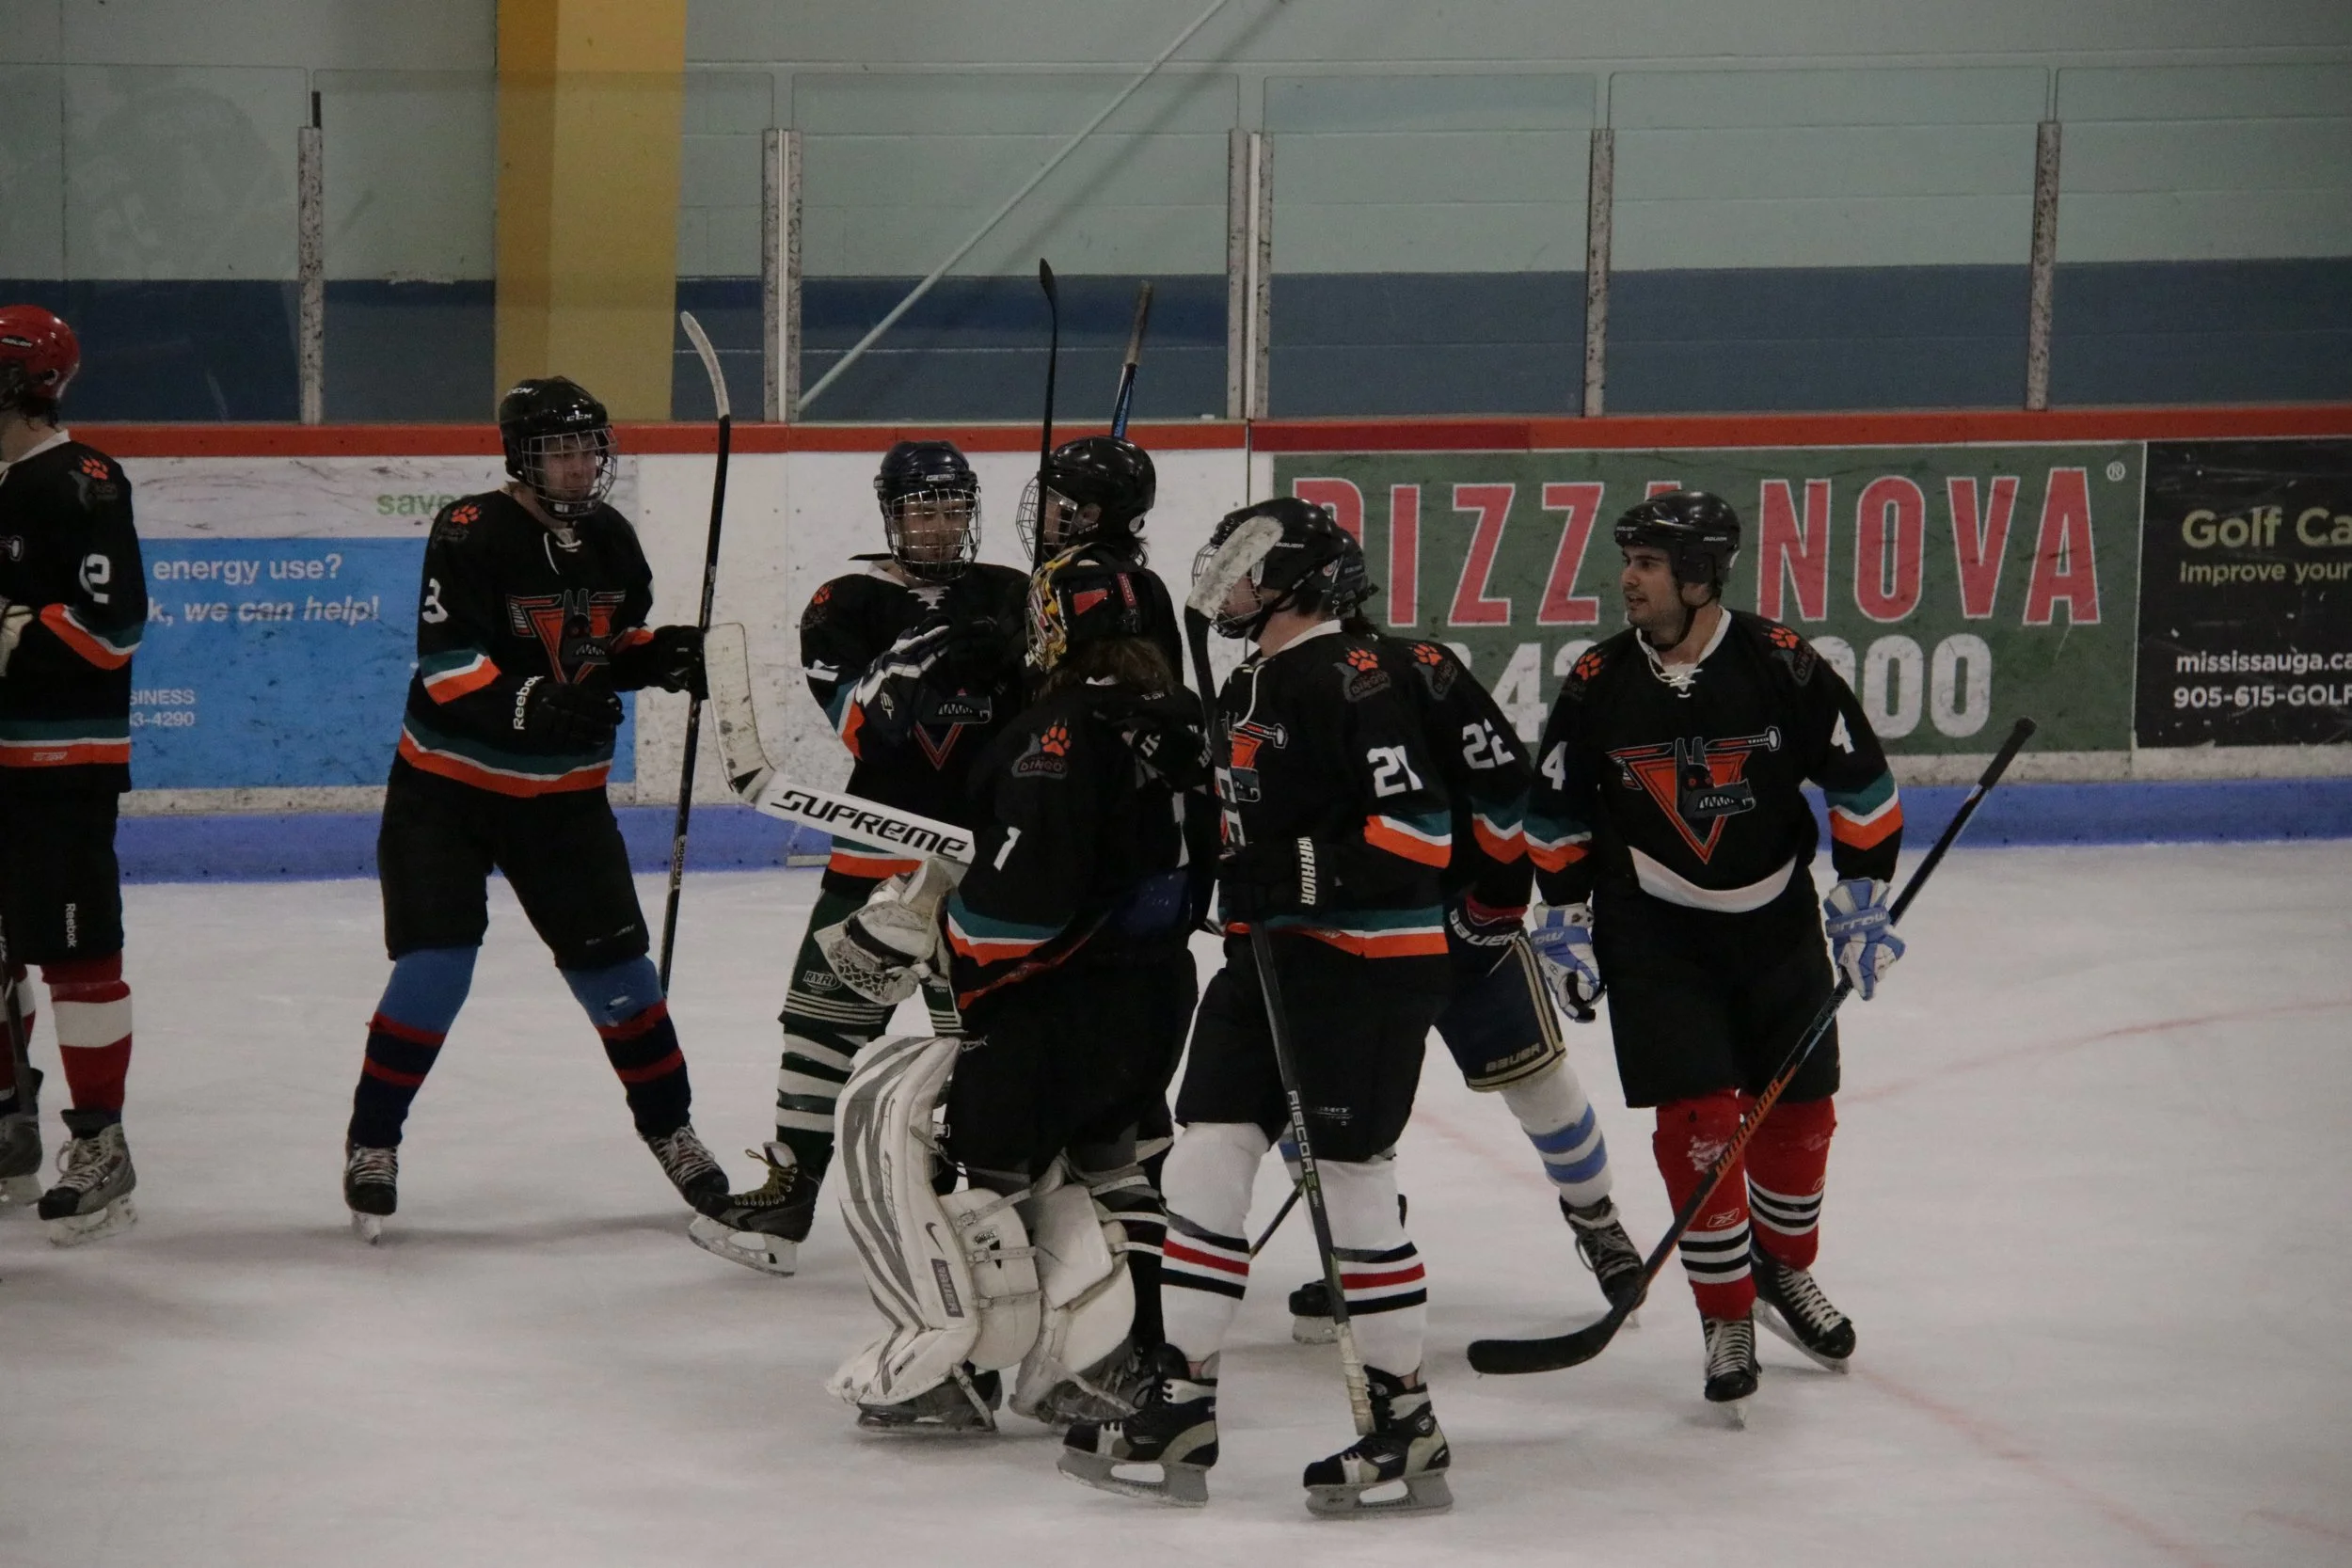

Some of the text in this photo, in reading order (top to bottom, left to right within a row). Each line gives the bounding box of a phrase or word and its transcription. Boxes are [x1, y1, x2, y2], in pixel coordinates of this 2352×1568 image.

[2182, 505, 2283, 549] Golf
[1293, 477, 1682, 627] IZZ
[1756, 467, 2101, 625] NOVA
[152, 553, 343, 586] energy use?
[2180, 561, 2352, 587] Improve your
[184, 601, 230, 623] we
[237, 601, 294, 623] can
[303, 595, 380, 626] help!
[421, 577, 449, 615] 3
[2175, 649, 2352, 675] mississauga.ca
[130, 689, 196, 705] SINESS
[130, 710, 196, 728] 3-4290
[1830, 709, 1856, 746] 4
[1366, 744, 1424, 799] 21
[1541, 740, 1569, 792] 4
[993, 825, 1023, 872] 1
[64, 902, 78, 949] Reebok
[1485, 1041, 1541, 1073] BAUER
